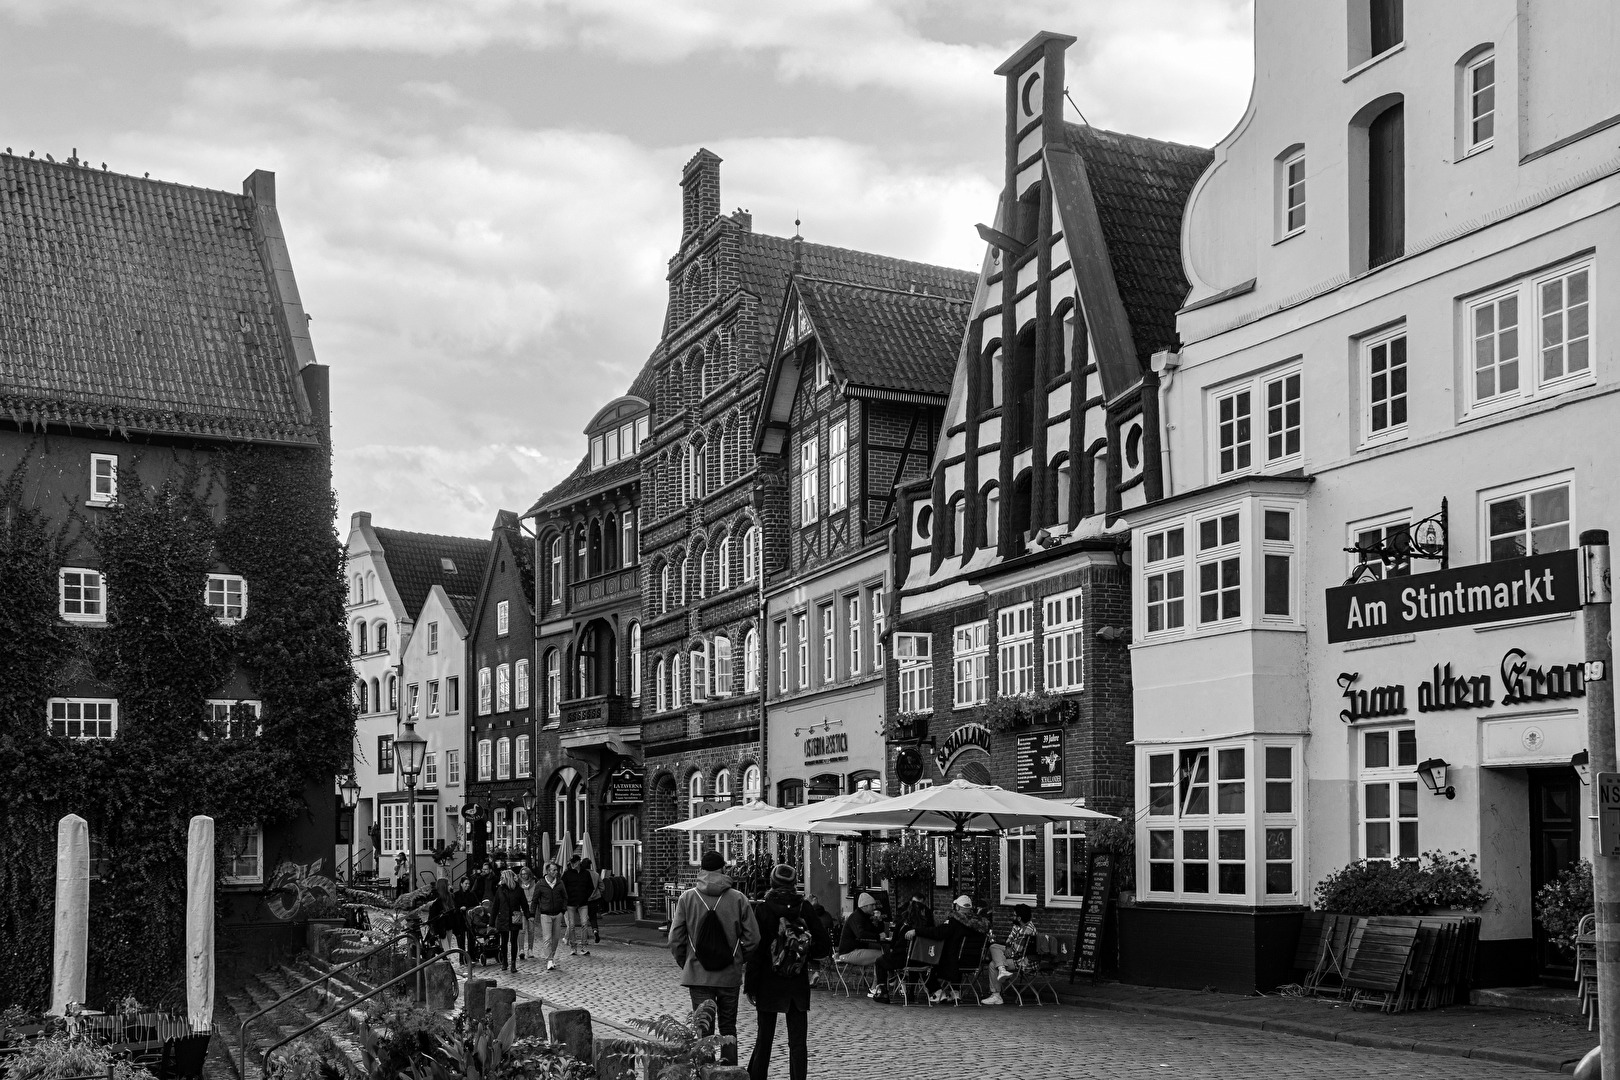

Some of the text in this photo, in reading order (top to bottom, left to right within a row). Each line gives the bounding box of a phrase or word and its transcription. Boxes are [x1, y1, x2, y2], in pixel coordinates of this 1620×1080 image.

[1347, 568, 1556, 630] Am Stintmarkt
[1337, 671, 1408, 724] Zum
[1418, 661, 1495, 713] alten
